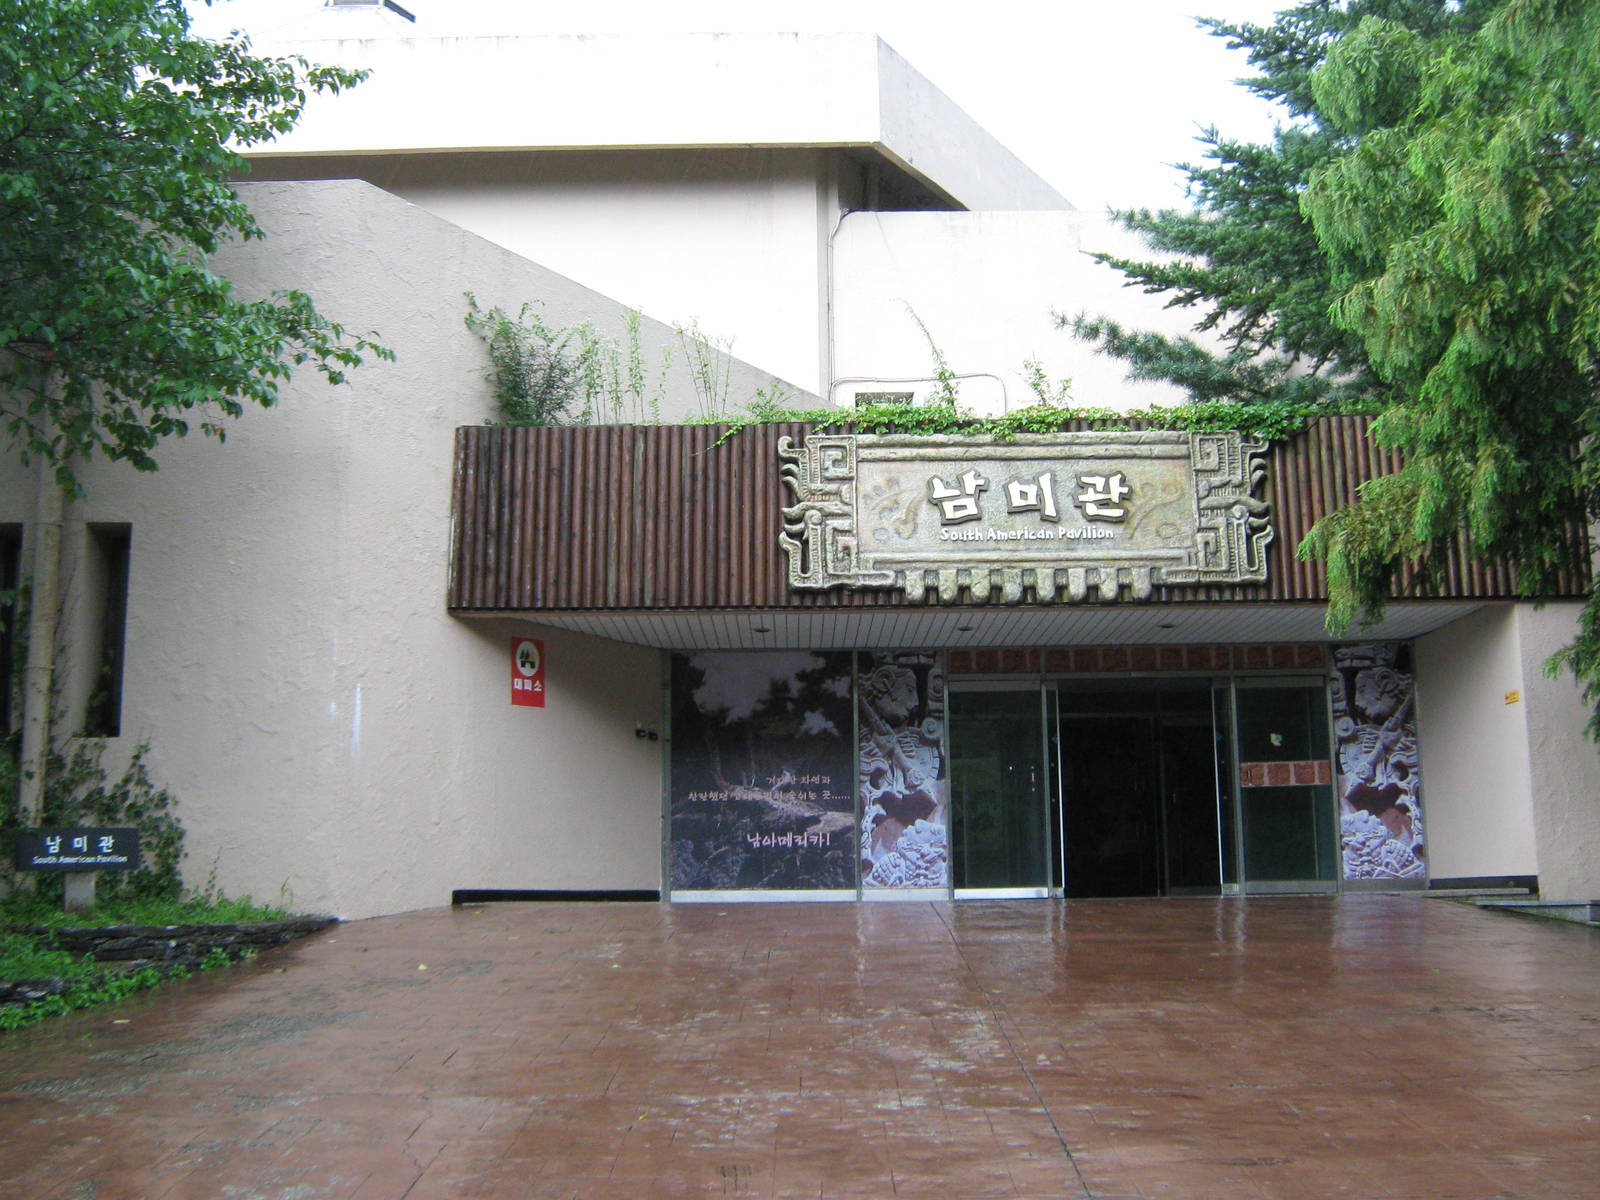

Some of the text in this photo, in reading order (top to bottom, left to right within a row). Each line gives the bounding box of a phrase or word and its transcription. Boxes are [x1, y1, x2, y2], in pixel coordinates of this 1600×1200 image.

[930, 469, 1131, 522] 남미관
[940, 526, 1114, 542] South American Pavilion
[514, 678, 542, 691] 대피소
[801, 775, 830, 785] 자연과
[45, 835, 115, 854] 남미관
[746, 831, 831, 849] 남아메리카!
[32, 855, 129, 865] South American Pavilion
